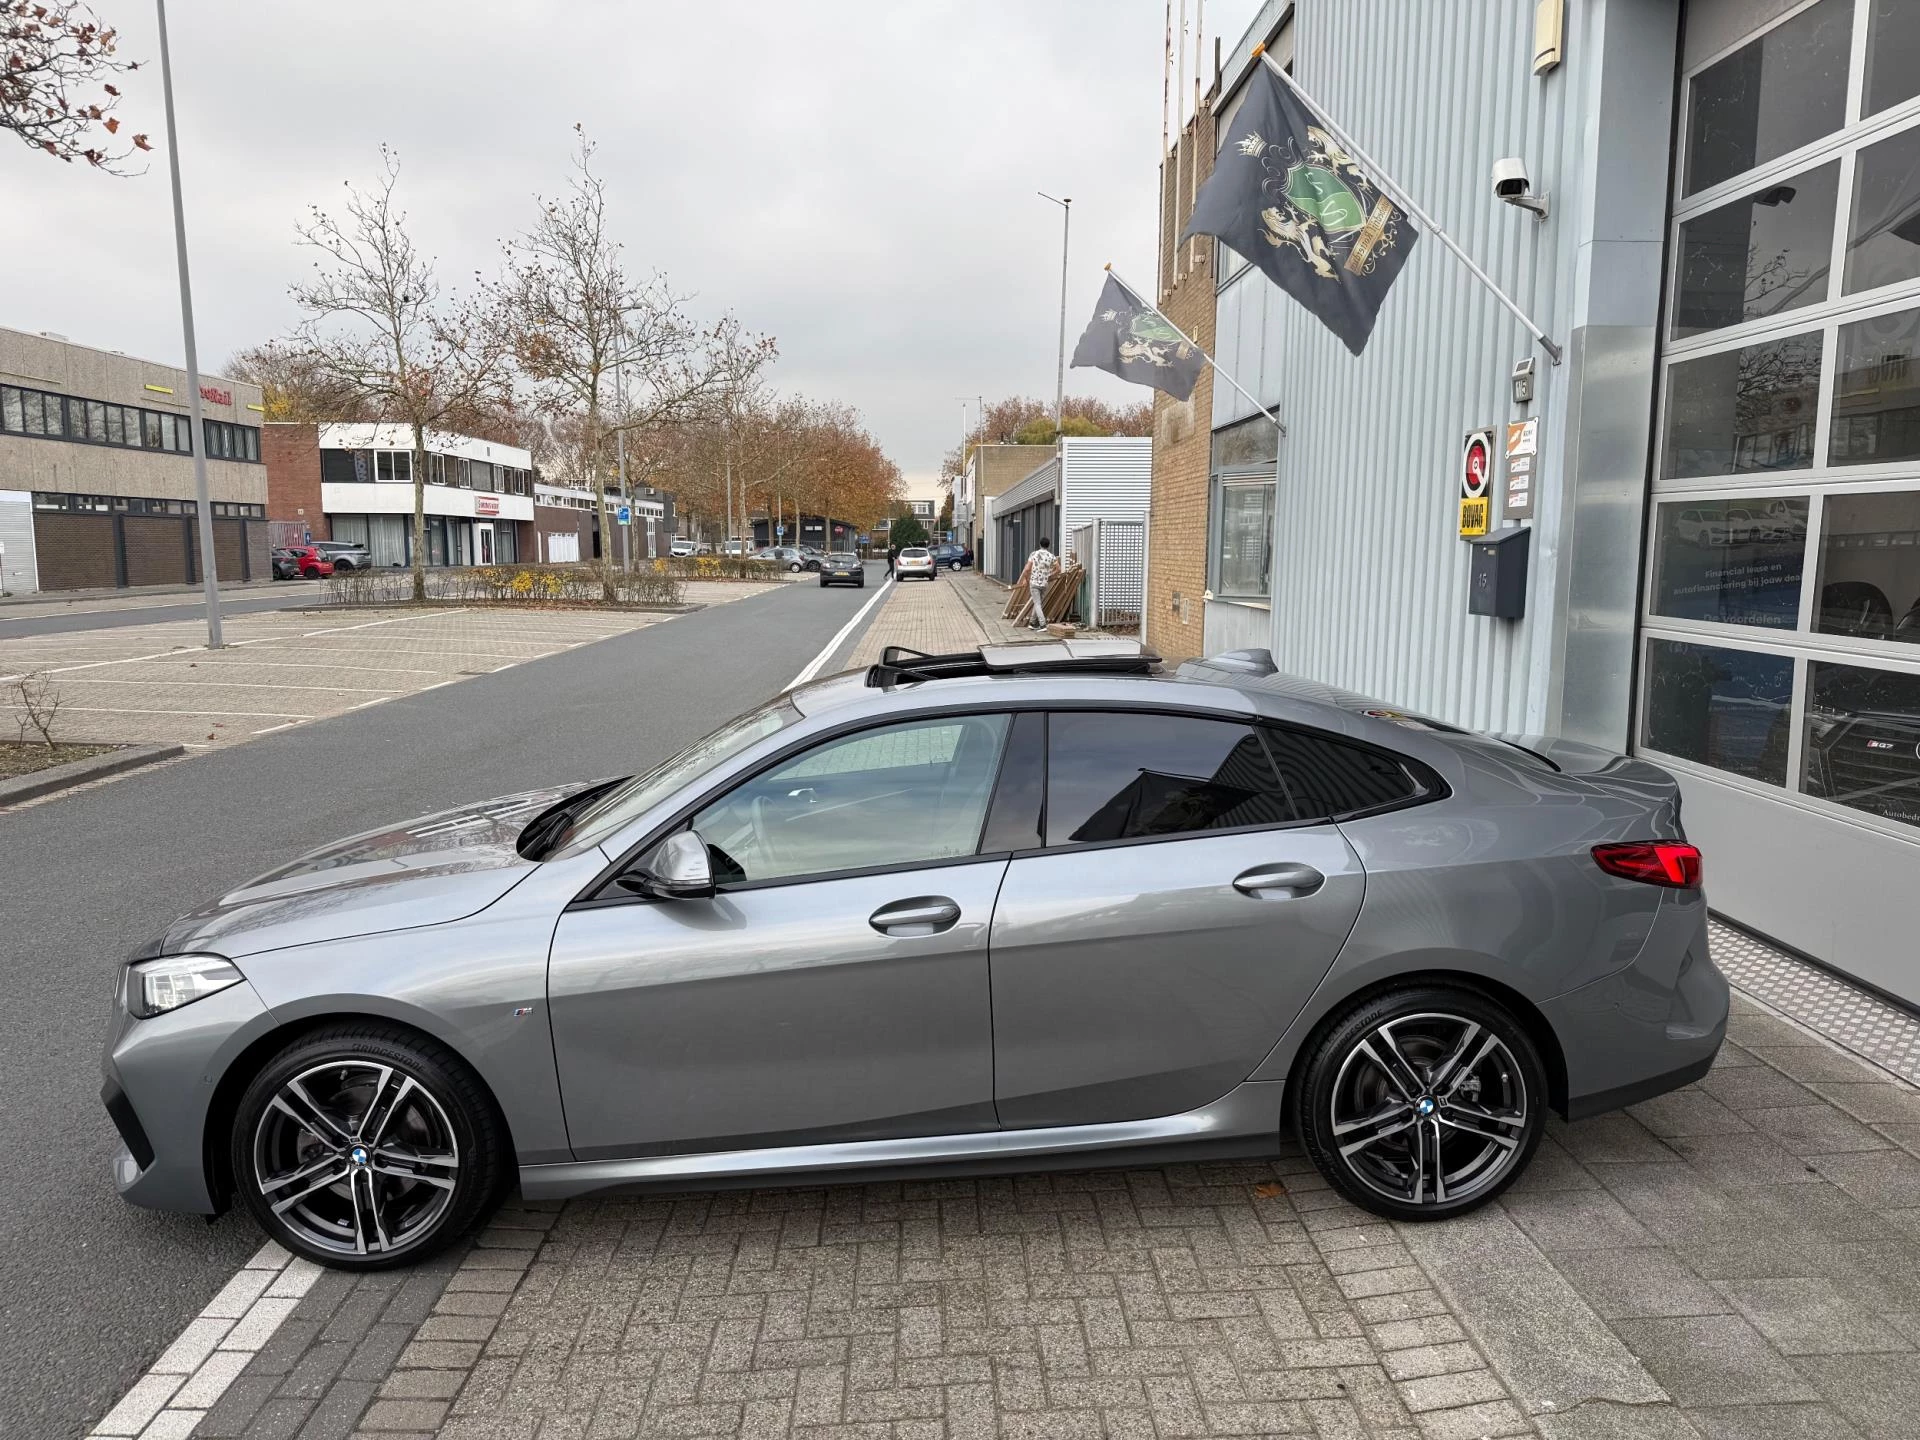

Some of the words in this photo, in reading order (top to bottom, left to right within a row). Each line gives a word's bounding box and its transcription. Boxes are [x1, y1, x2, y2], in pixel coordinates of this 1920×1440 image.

[1462, 504, 1484, 528] BOVAG
[1705, 566, 1746, 578] Financial
[1479, 572, 1487, 589] 15
[1748, 576, 1759, 587] bij
[1760, 576, 1782, 587] jouw
